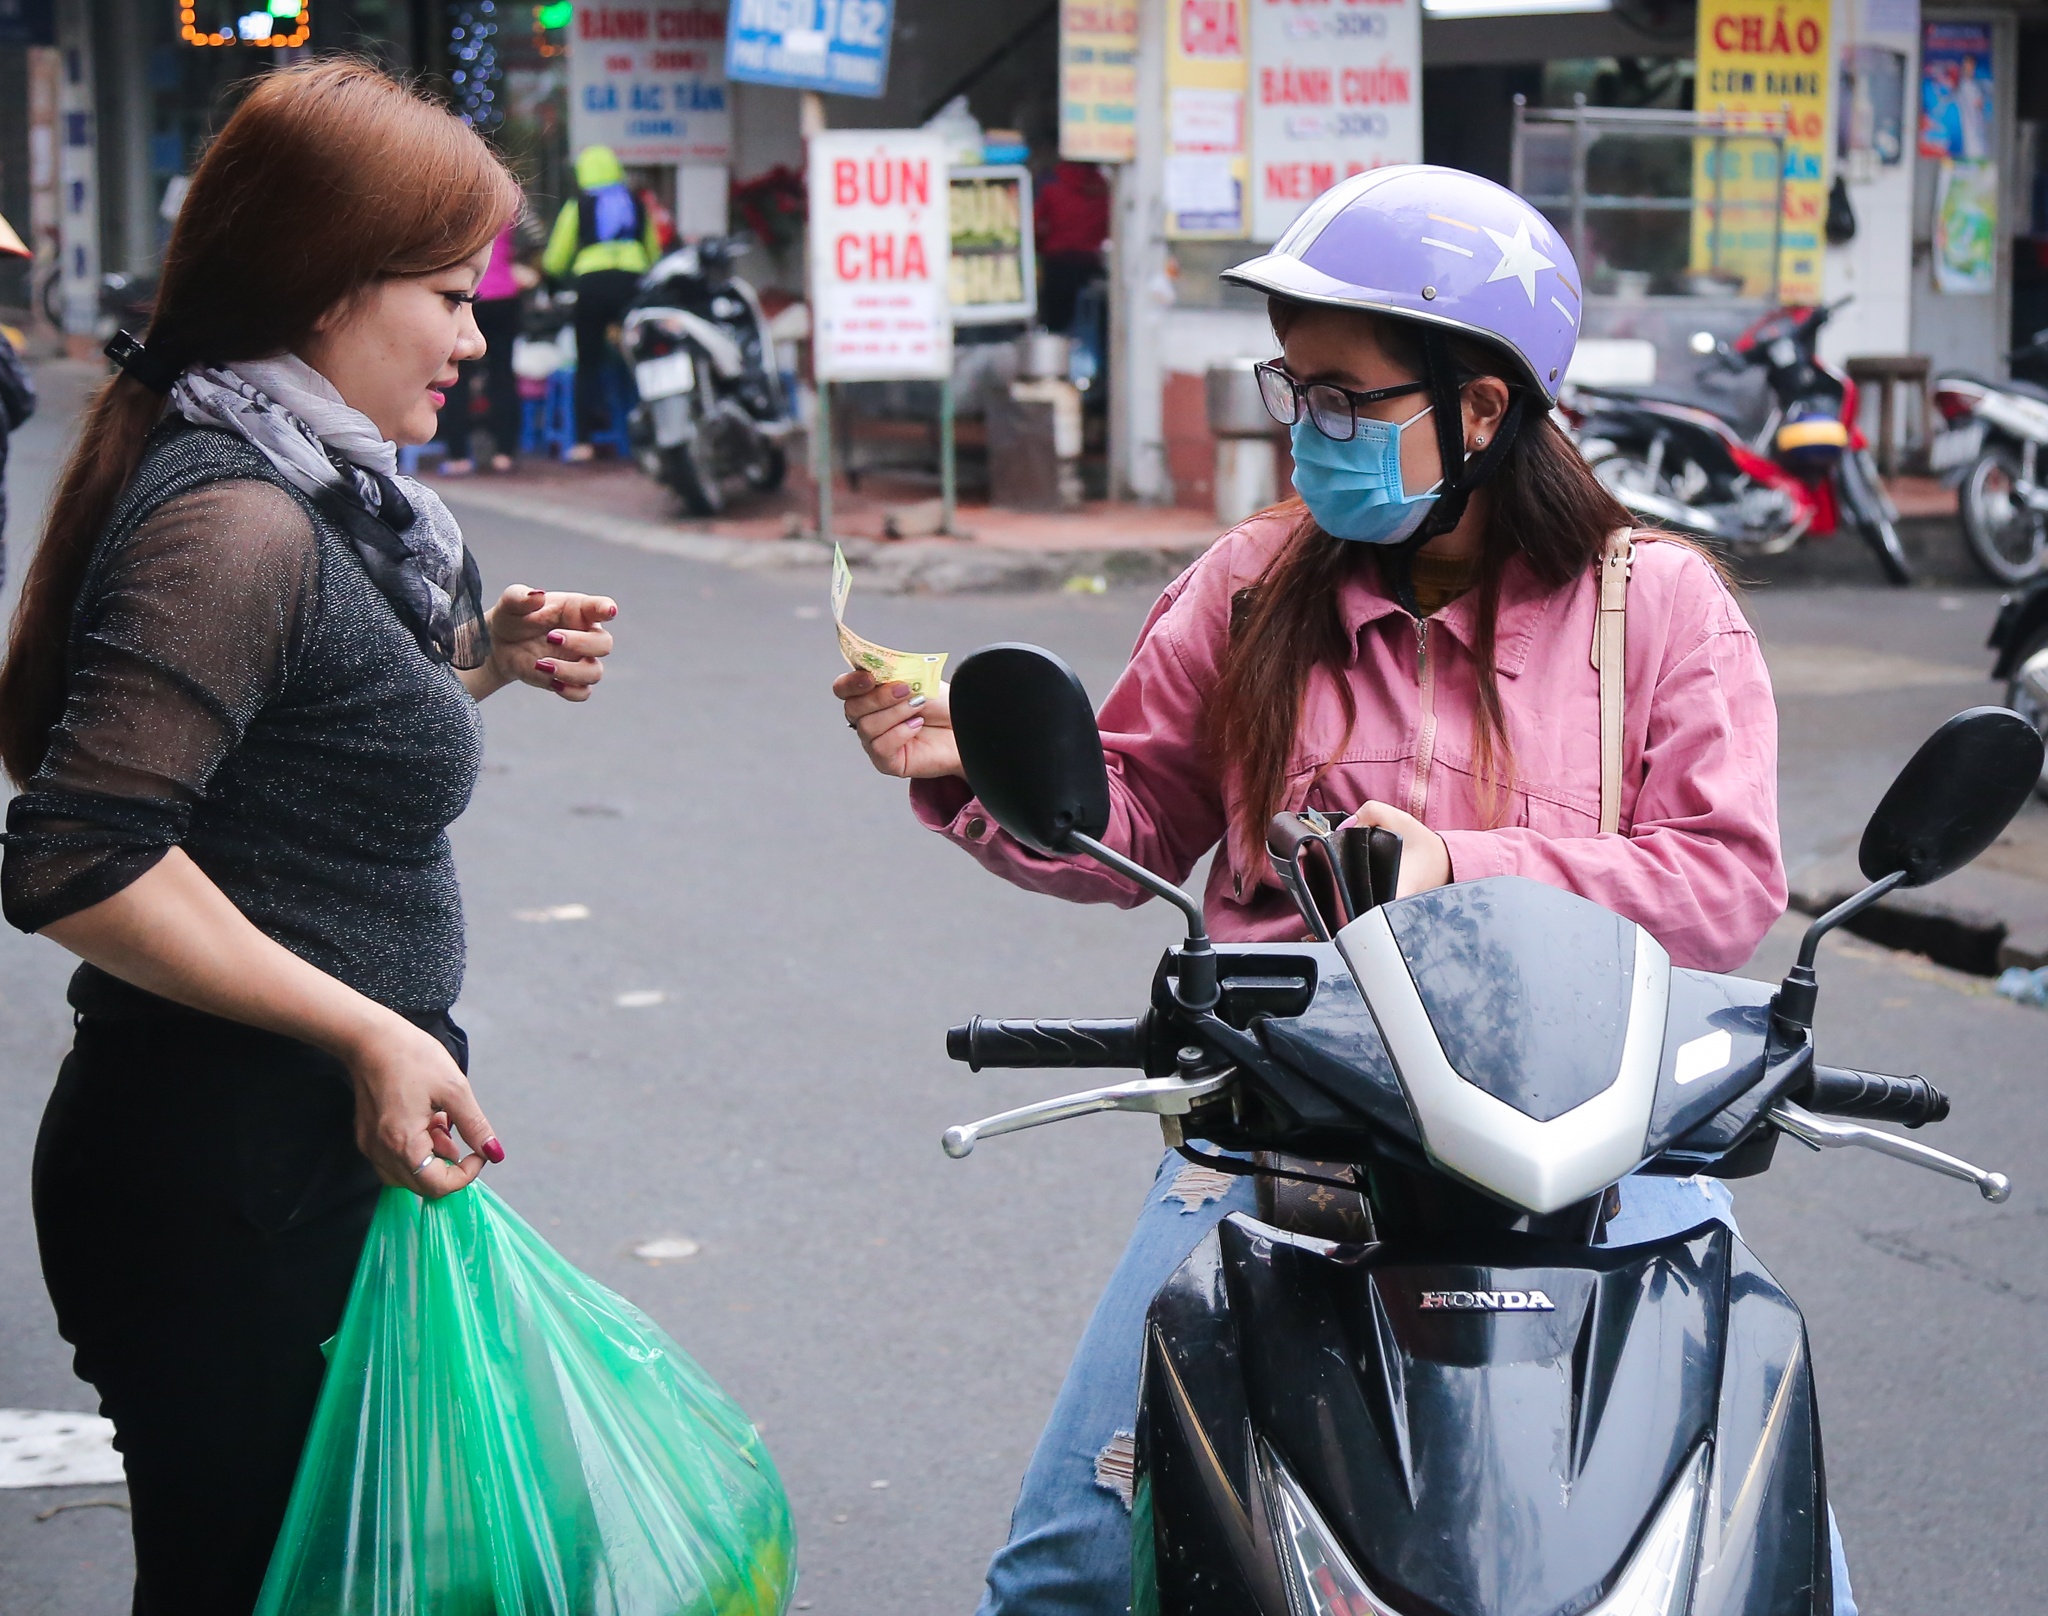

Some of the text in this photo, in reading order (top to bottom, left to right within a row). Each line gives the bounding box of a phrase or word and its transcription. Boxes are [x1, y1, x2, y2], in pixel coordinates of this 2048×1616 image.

[825, 0, 886, 46] 162
[1262, 52, 1410, 105] BÁNH CUỐN
[834, 145, 929, 206] BÚN
[1264, 161, 1335, 200] NEM
[1419, 1290, 1555, 1311] HONDA
